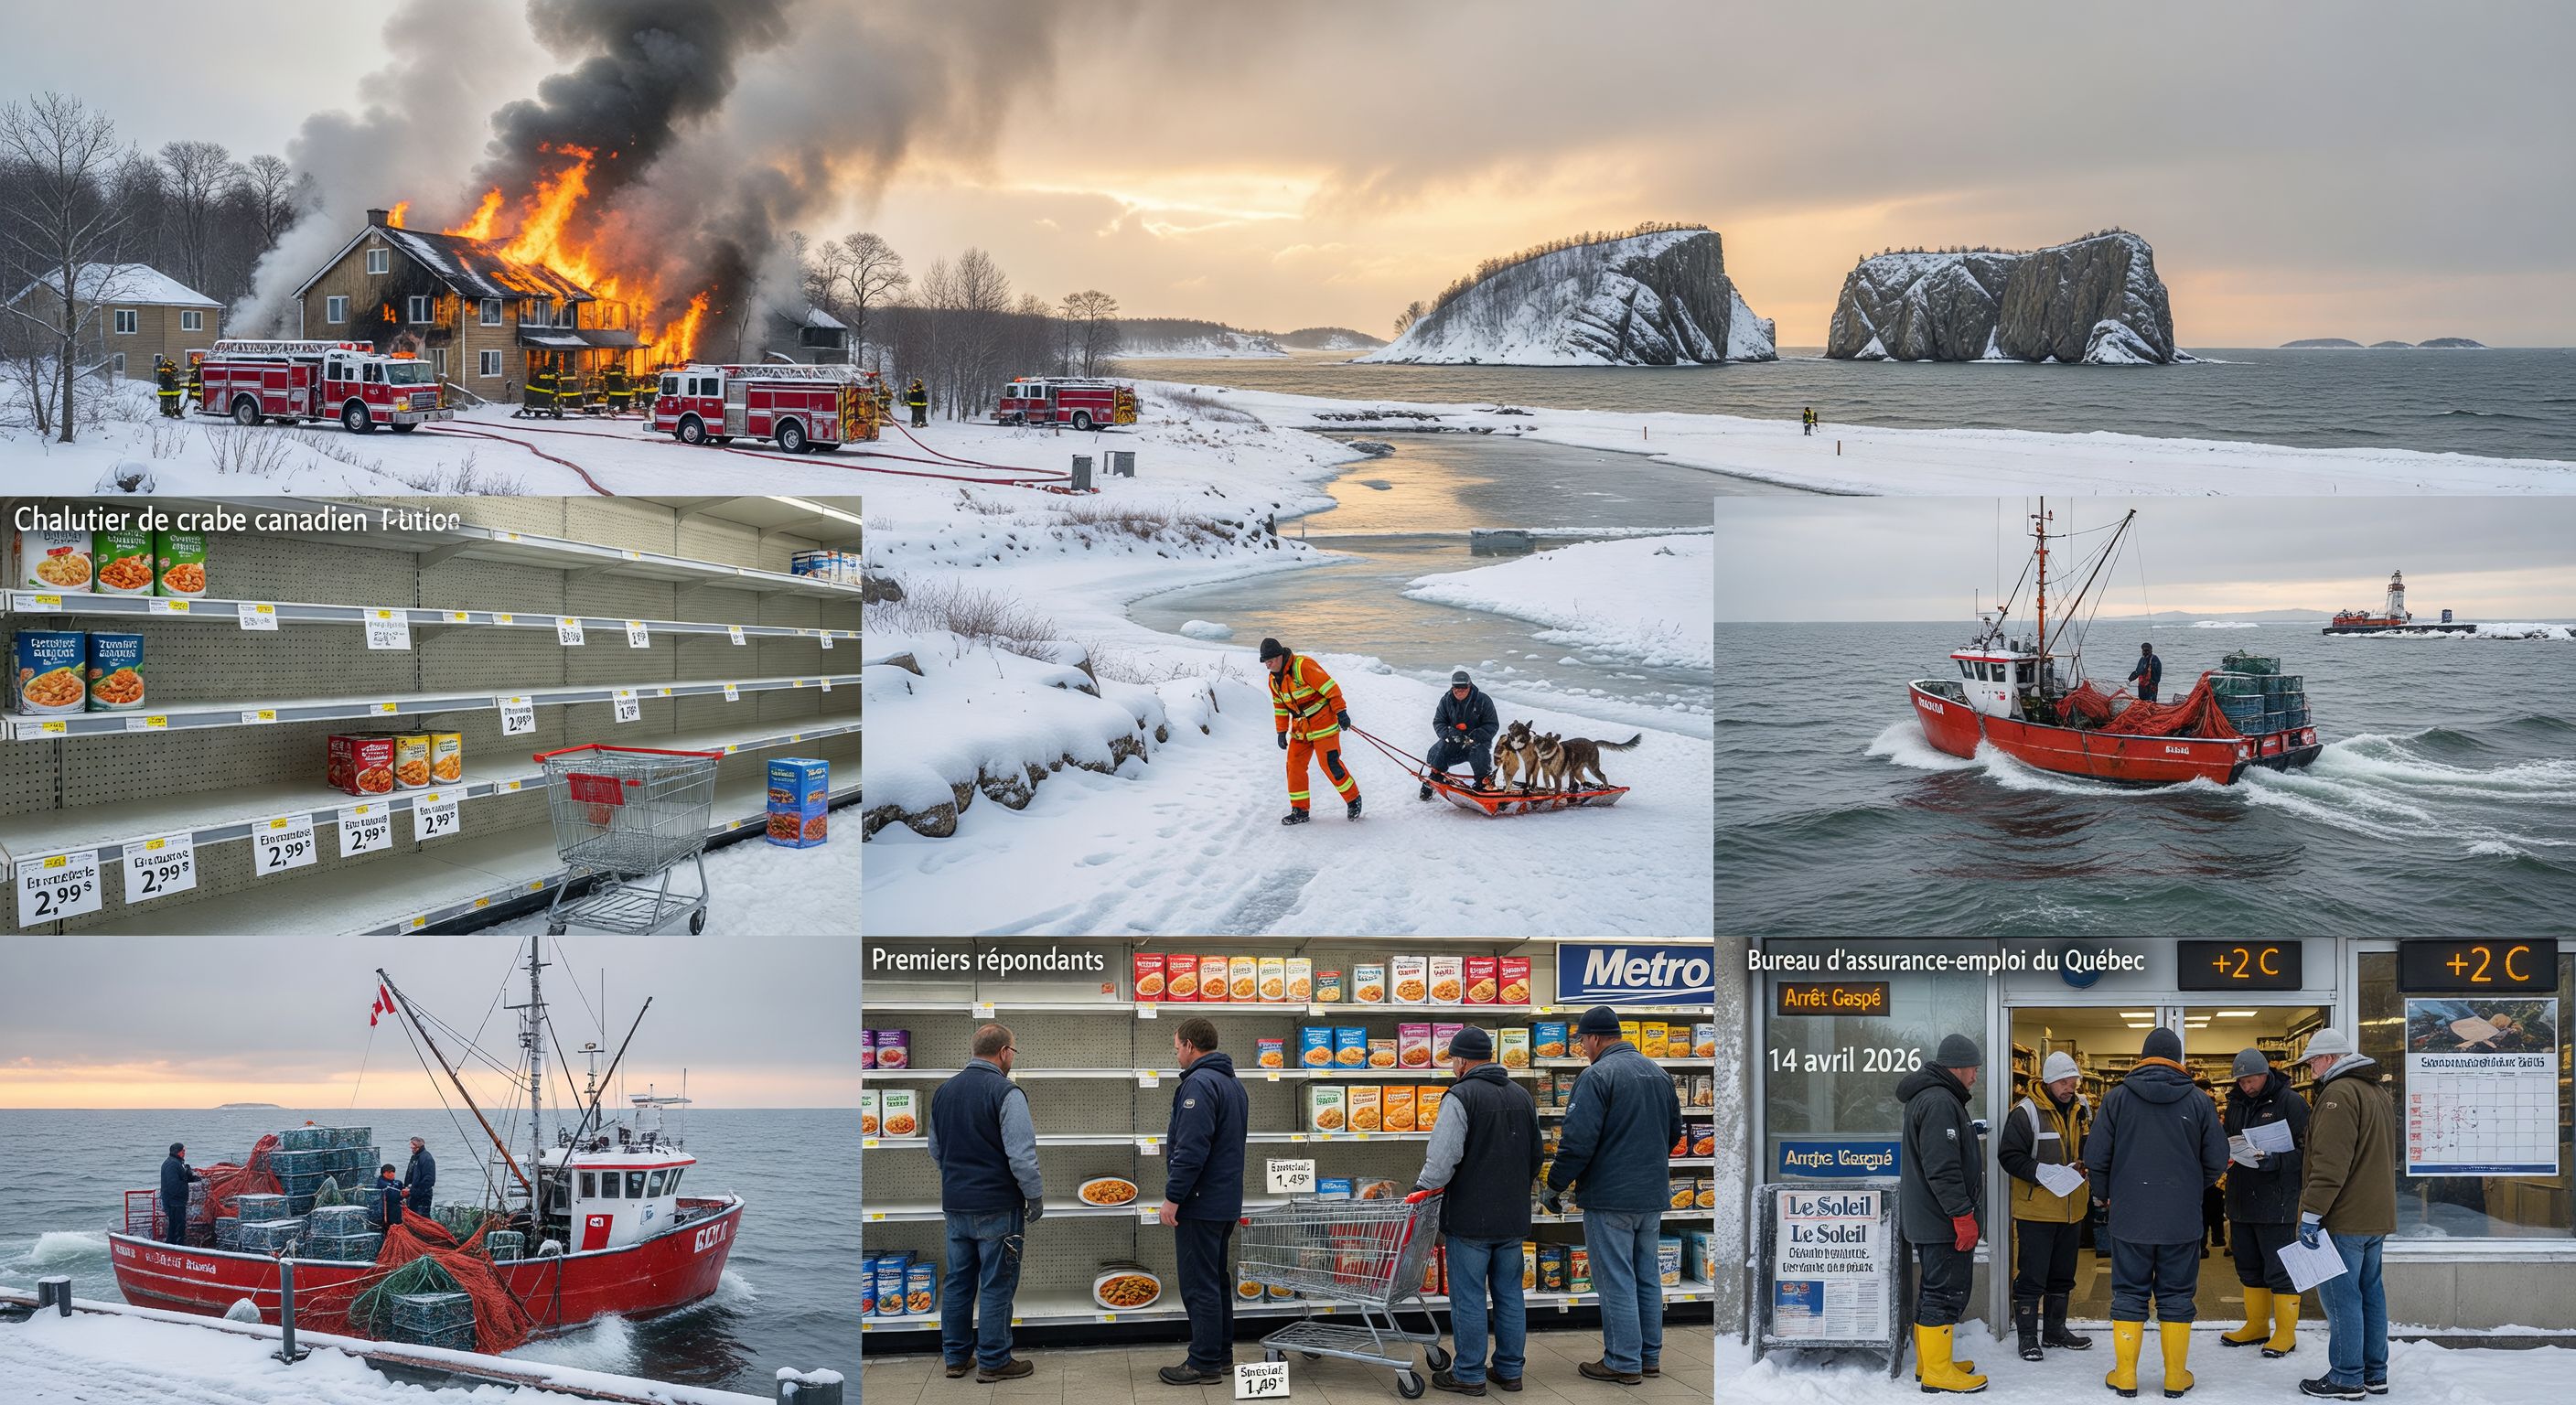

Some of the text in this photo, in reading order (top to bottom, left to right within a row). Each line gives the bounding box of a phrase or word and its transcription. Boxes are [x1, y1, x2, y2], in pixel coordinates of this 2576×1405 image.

[1583, 949, 1711, 988] Metro
[2213, 948, 2279, 979] +2 C
[2446, 945, 2529, 982] +2 C
[1785, 988, 1881, 1011] Arrêt Gaspé
[1789, 1196, 1872, 1217] Le Soleil
[1790, 1223, 1867, 1244] Le Soleil
